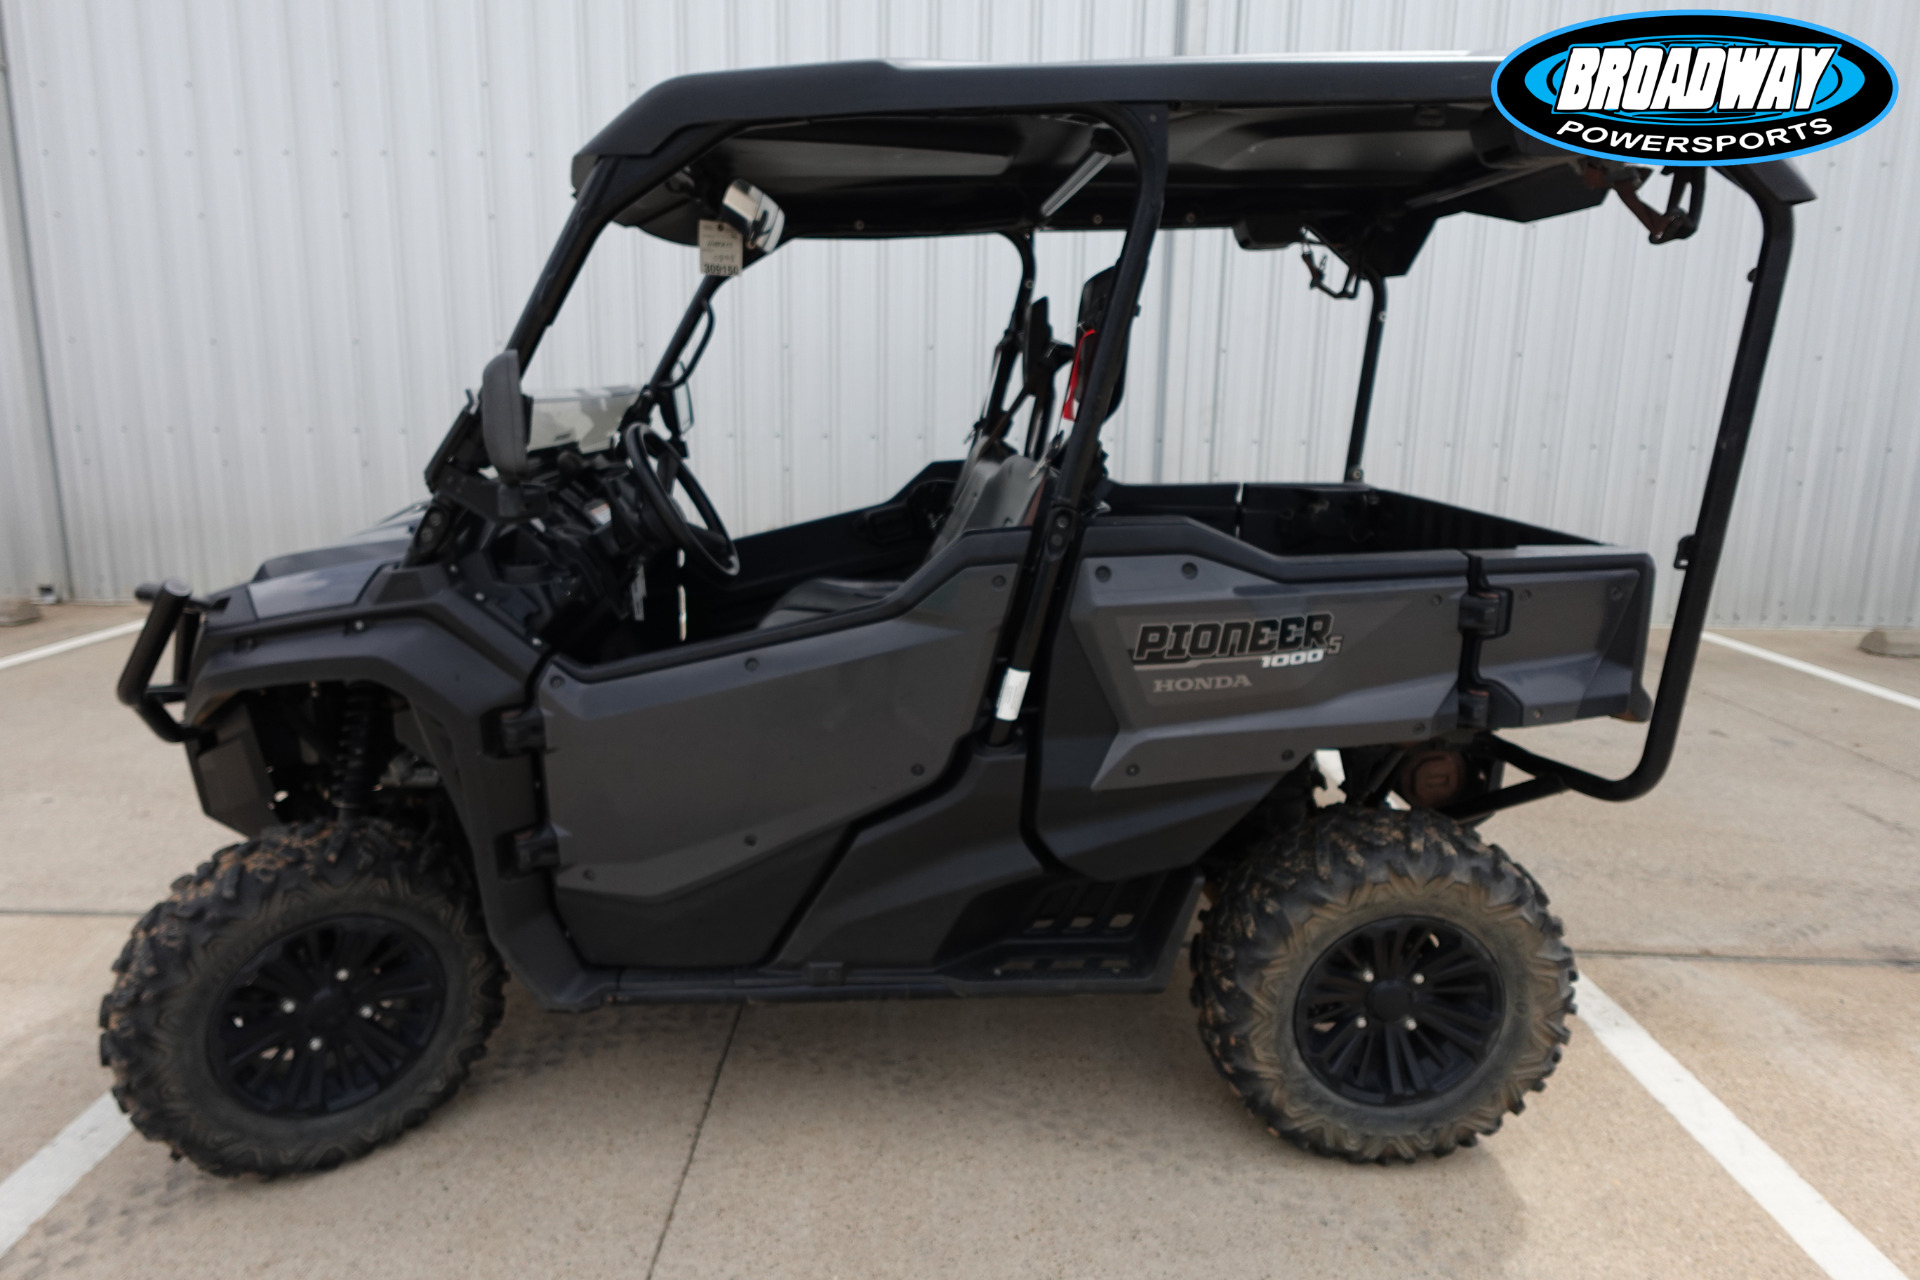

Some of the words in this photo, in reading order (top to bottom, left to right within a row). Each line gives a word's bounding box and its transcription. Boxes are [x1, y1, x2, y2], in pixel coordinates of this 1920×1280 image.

[1133, 613, 1334, 660] PIONEER
[1261, 648, 1325, 669] 1000
[1153, 674, 1252, 693] HONDA
